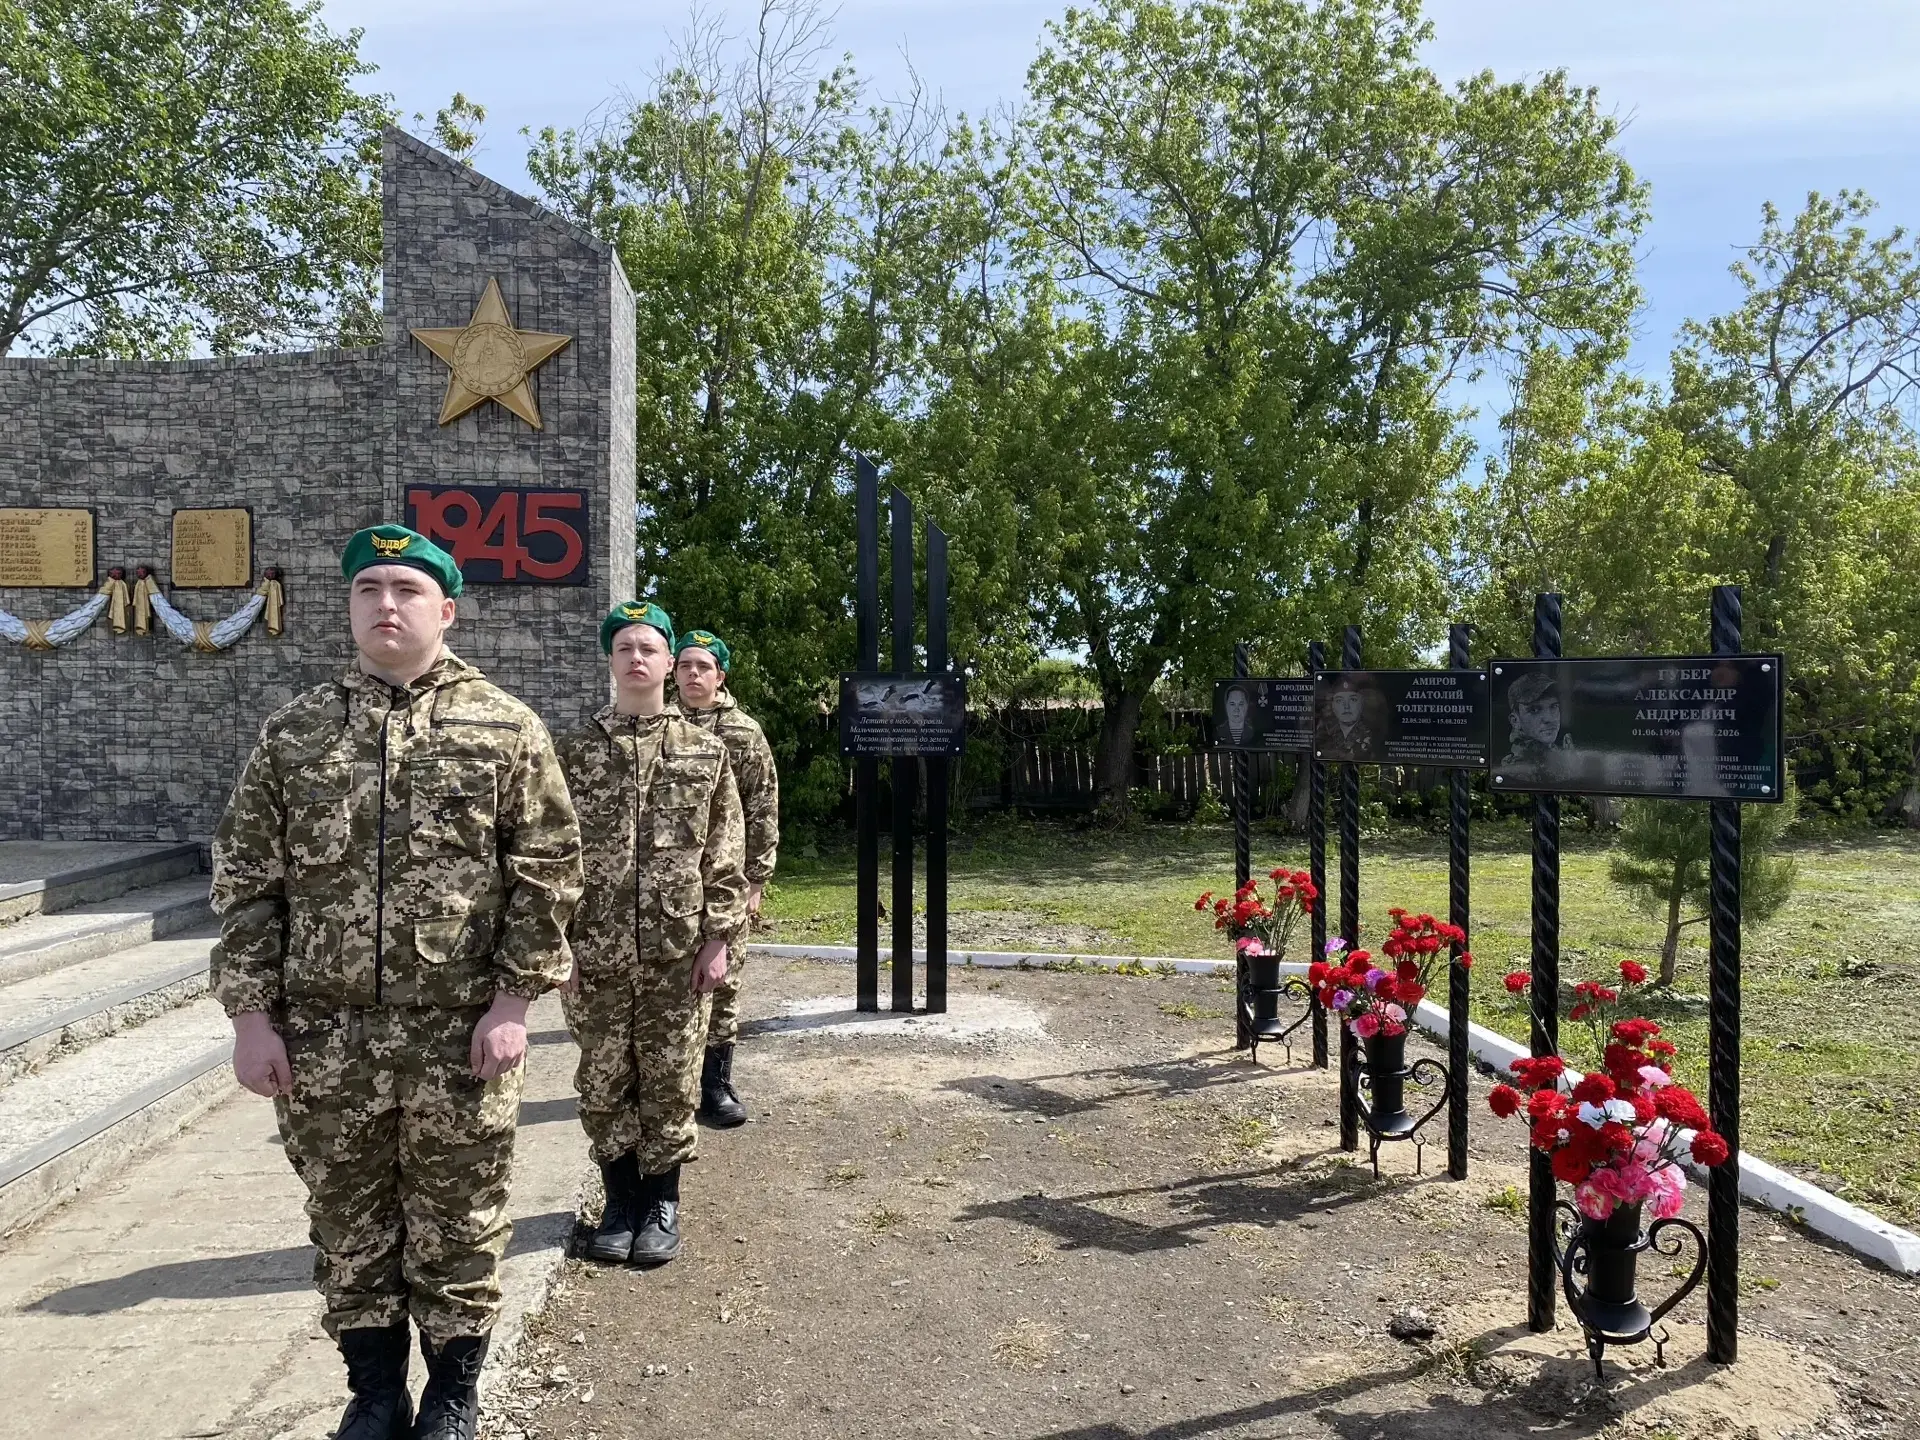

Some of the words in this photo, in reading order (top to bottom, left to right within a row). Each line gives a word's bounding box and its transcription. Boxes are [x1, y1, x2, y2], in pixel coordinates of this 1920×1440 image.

[409, 489, 583, 580] 1945
[380, 539, 399, 550] ВДВ
[1658, 668, 1712, 681] ГУБЕР
[1412, 677, 1456, 686] АМИРОВ
[1405, 689, 1464, 700] АНАТОЛИЙ
[1634, 688, 1738, 703] АЛЕКСАНДР
[1395, 704, 1473, 713] ТОЛЕГЕНОВИЧ
[1634, 709, 1737, 723] АНДРЕЕВИЧ
[1632, 728, 1680, 737] 01.06.1996
